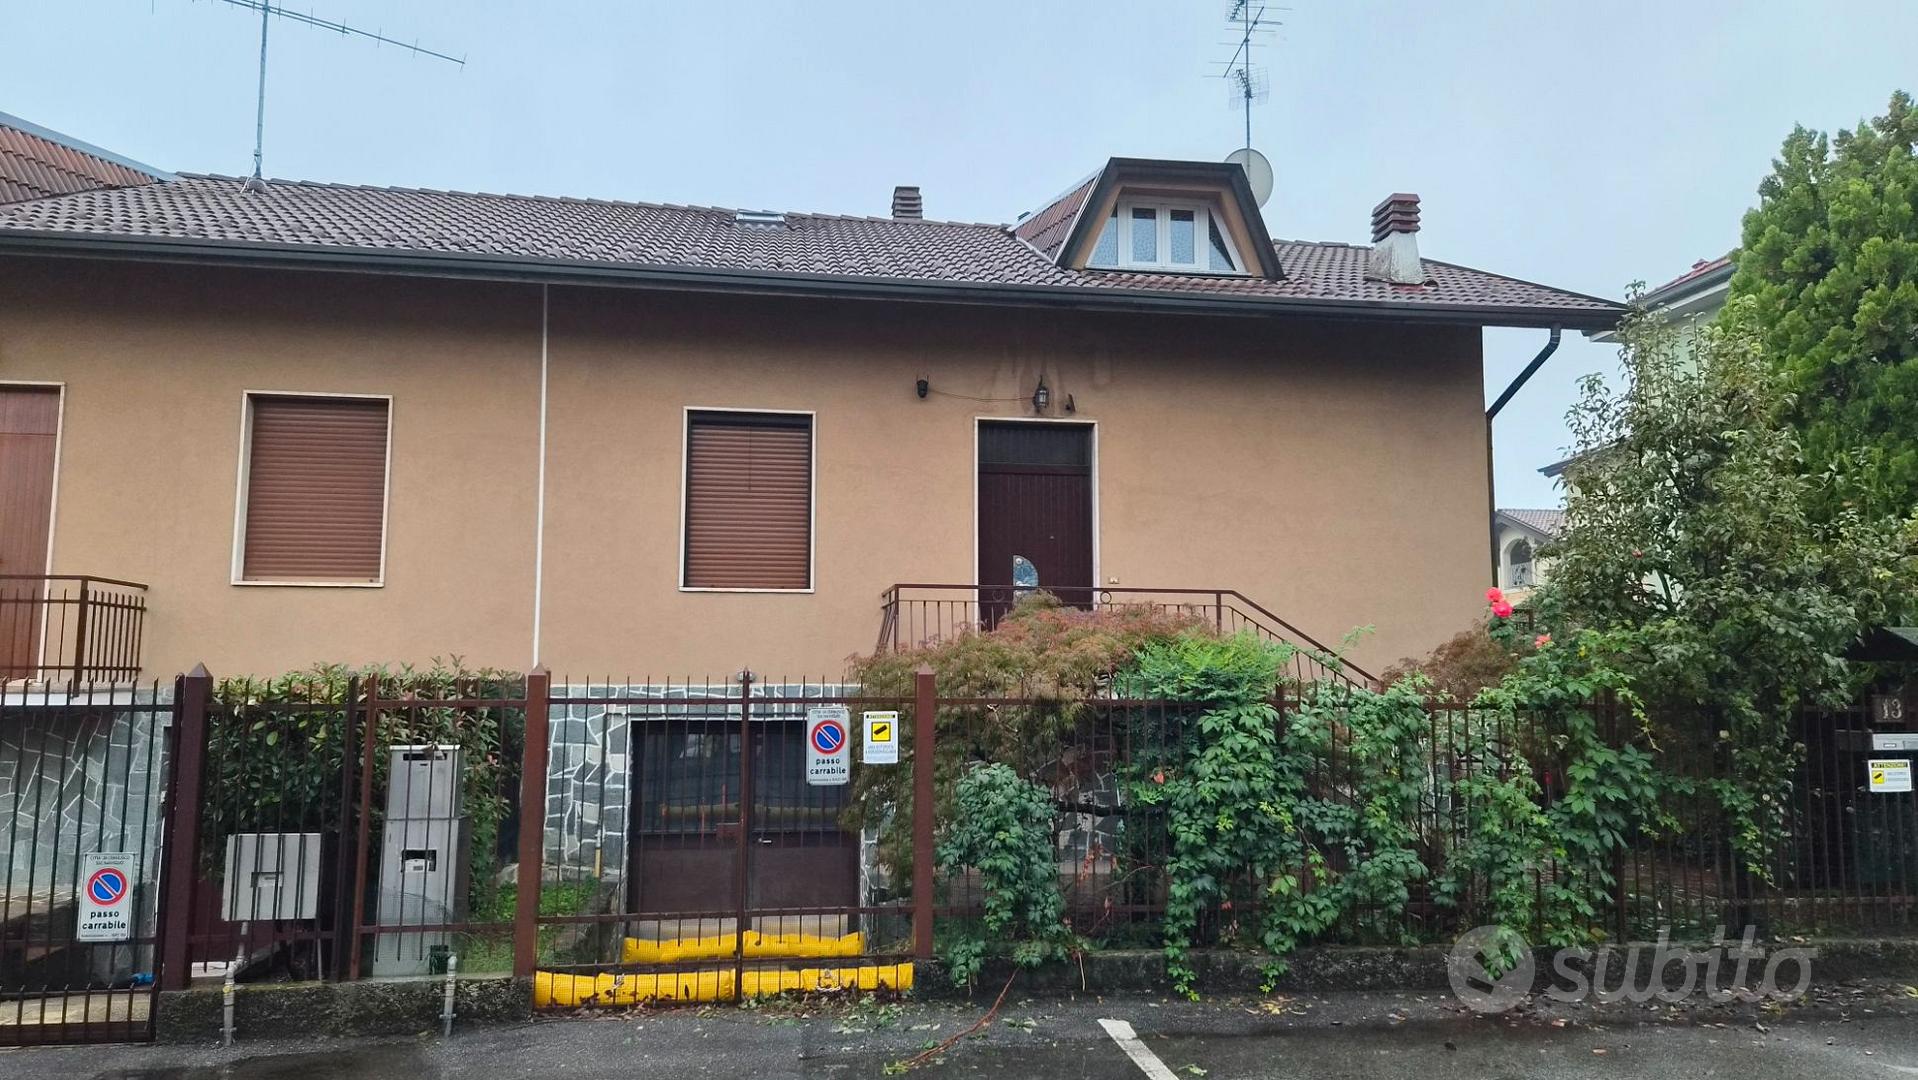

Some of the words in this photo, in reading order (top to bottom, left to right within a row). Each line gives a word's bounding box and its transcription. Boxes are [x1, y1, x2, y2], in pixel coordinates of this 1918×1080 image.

[1882, 698, 1902, 719] 13
[809, 766, 847, 775] carrabile
[90, 911, 120, 919] passo
[82, 920, 127, 930] carrabile
